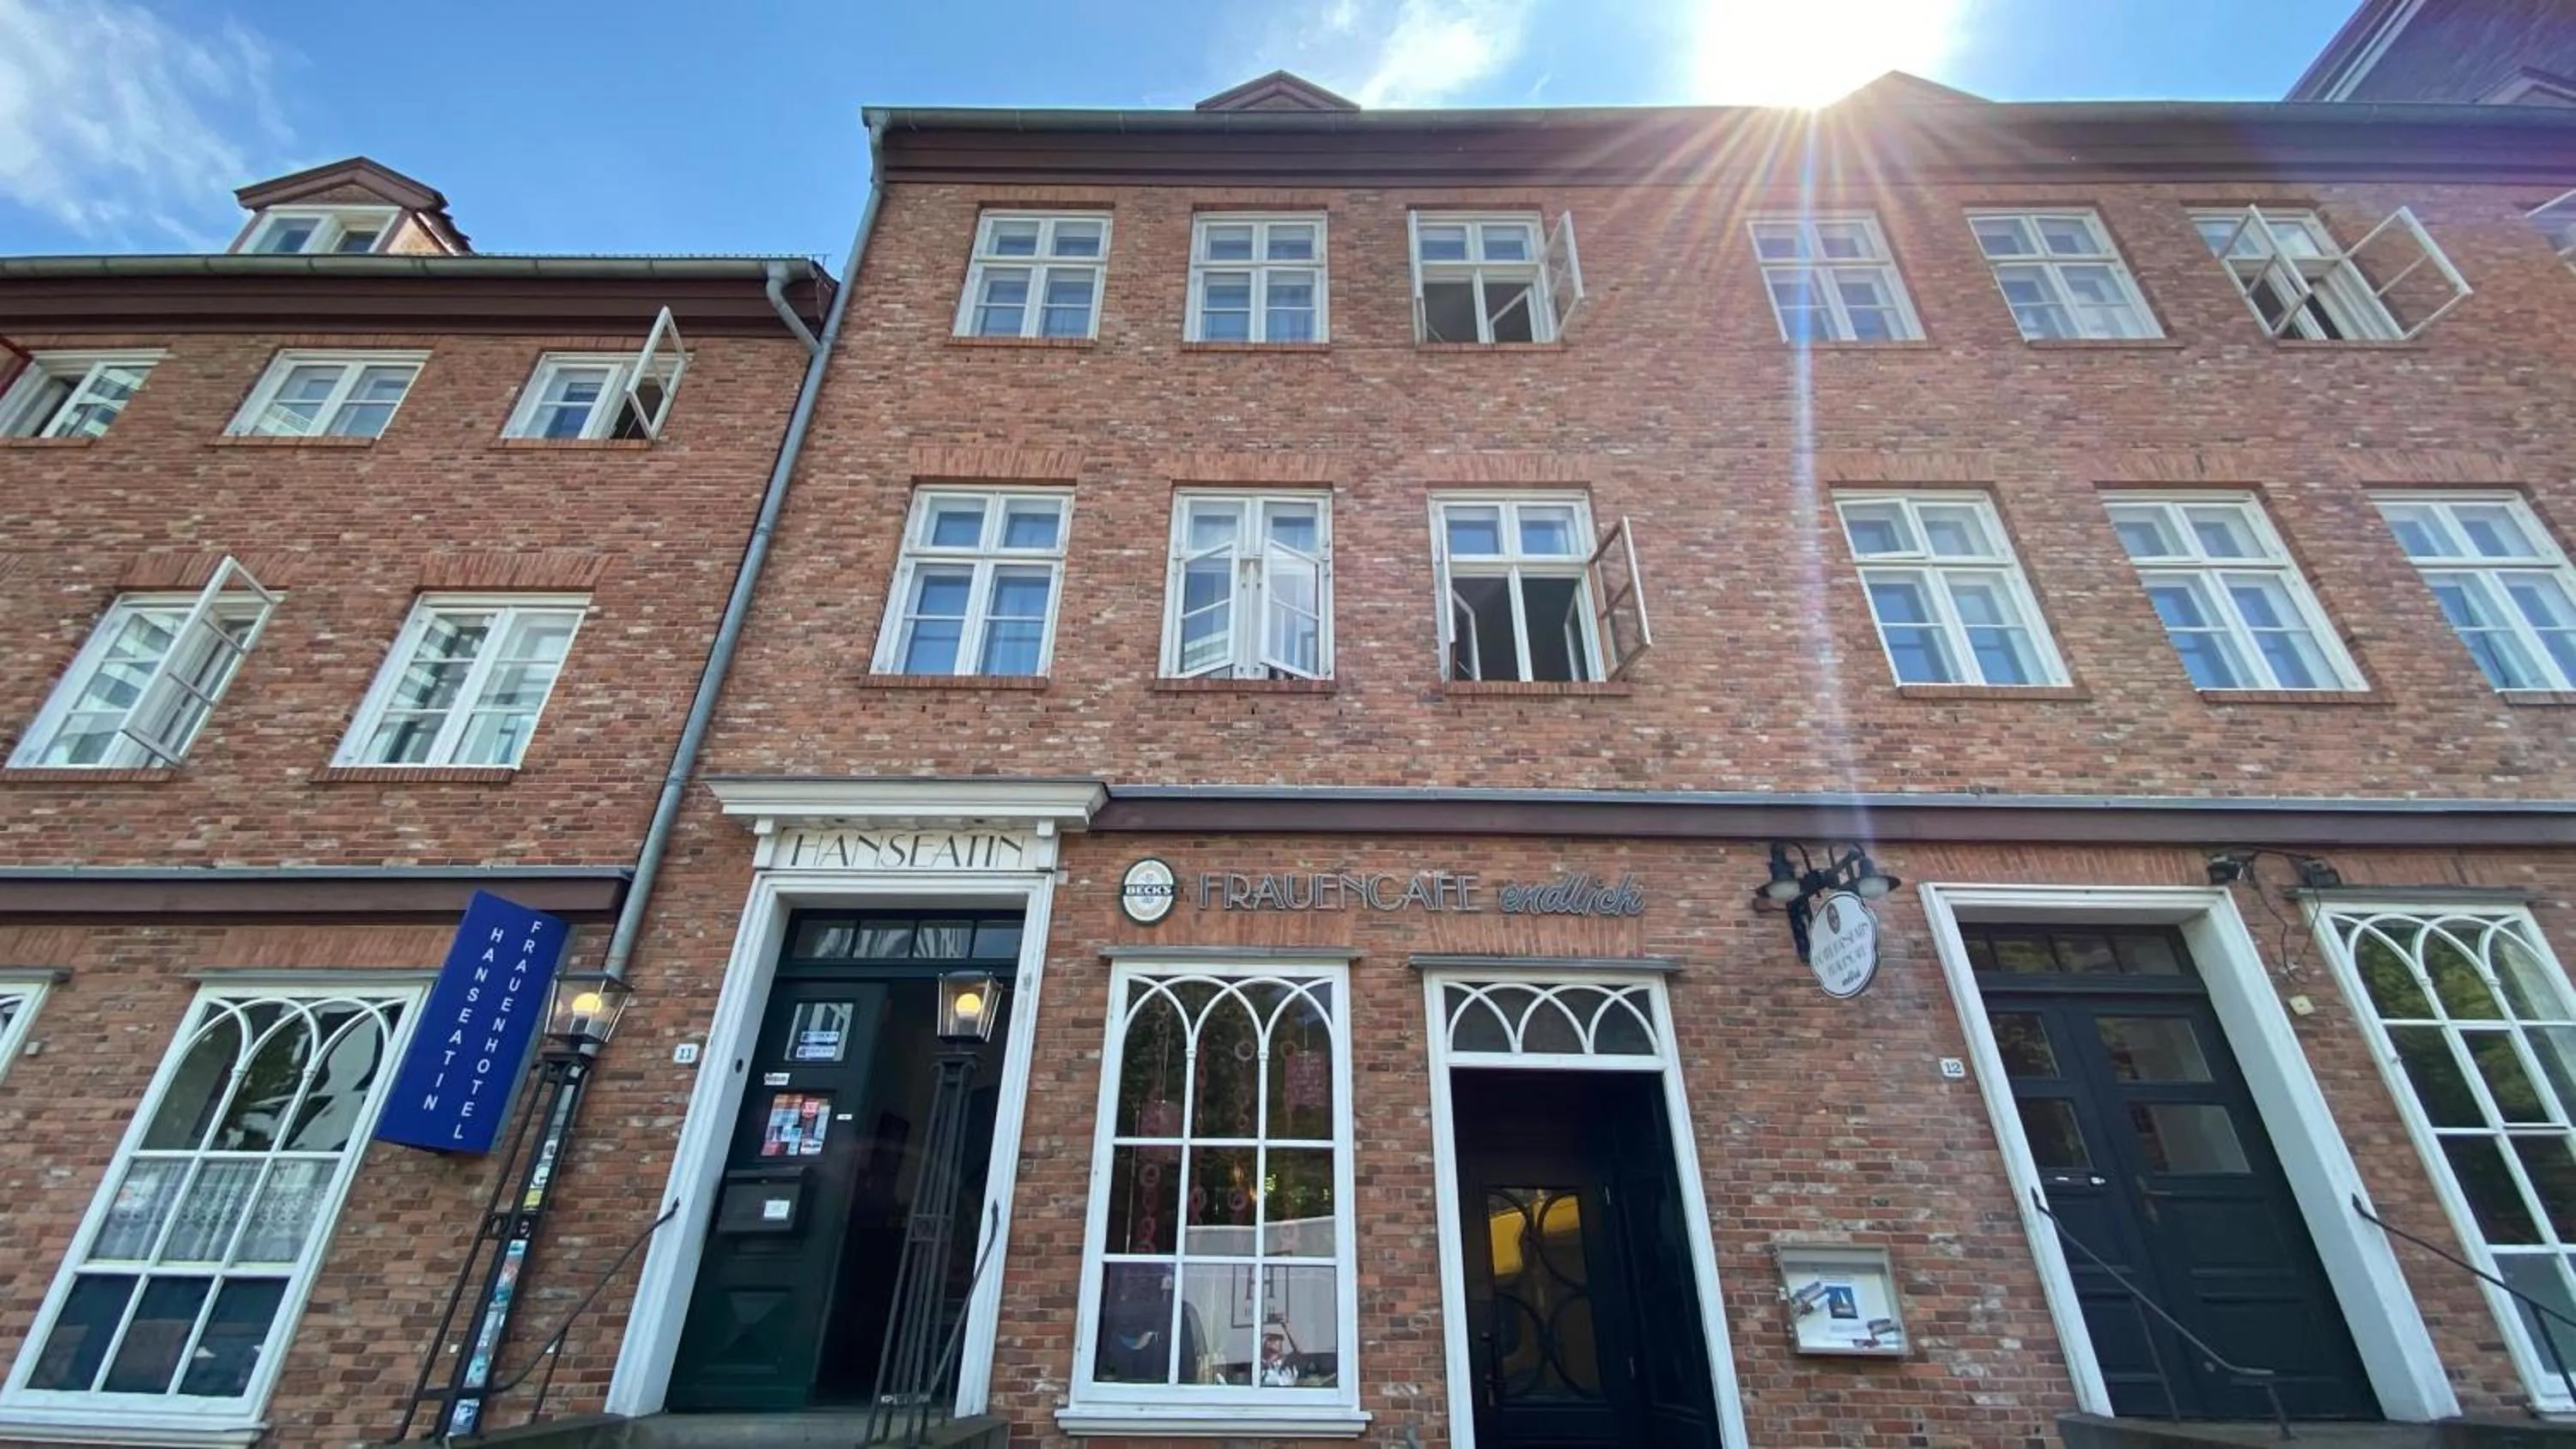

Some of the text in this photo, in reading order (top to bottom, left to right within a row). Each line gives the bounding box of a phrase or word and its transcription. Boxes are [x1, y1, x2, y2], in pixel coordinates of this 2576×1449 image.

[791, 833, 1026, 869] HANSEATIN
[1199, 870, 1647, 916] FRAUENCAFE endlich
[422, 926, 505, 1112] HANSEATIN
[453, 920, 544, 1140] FRAUENHOTEL
[1943, 1061, 1962, 1074] 12
